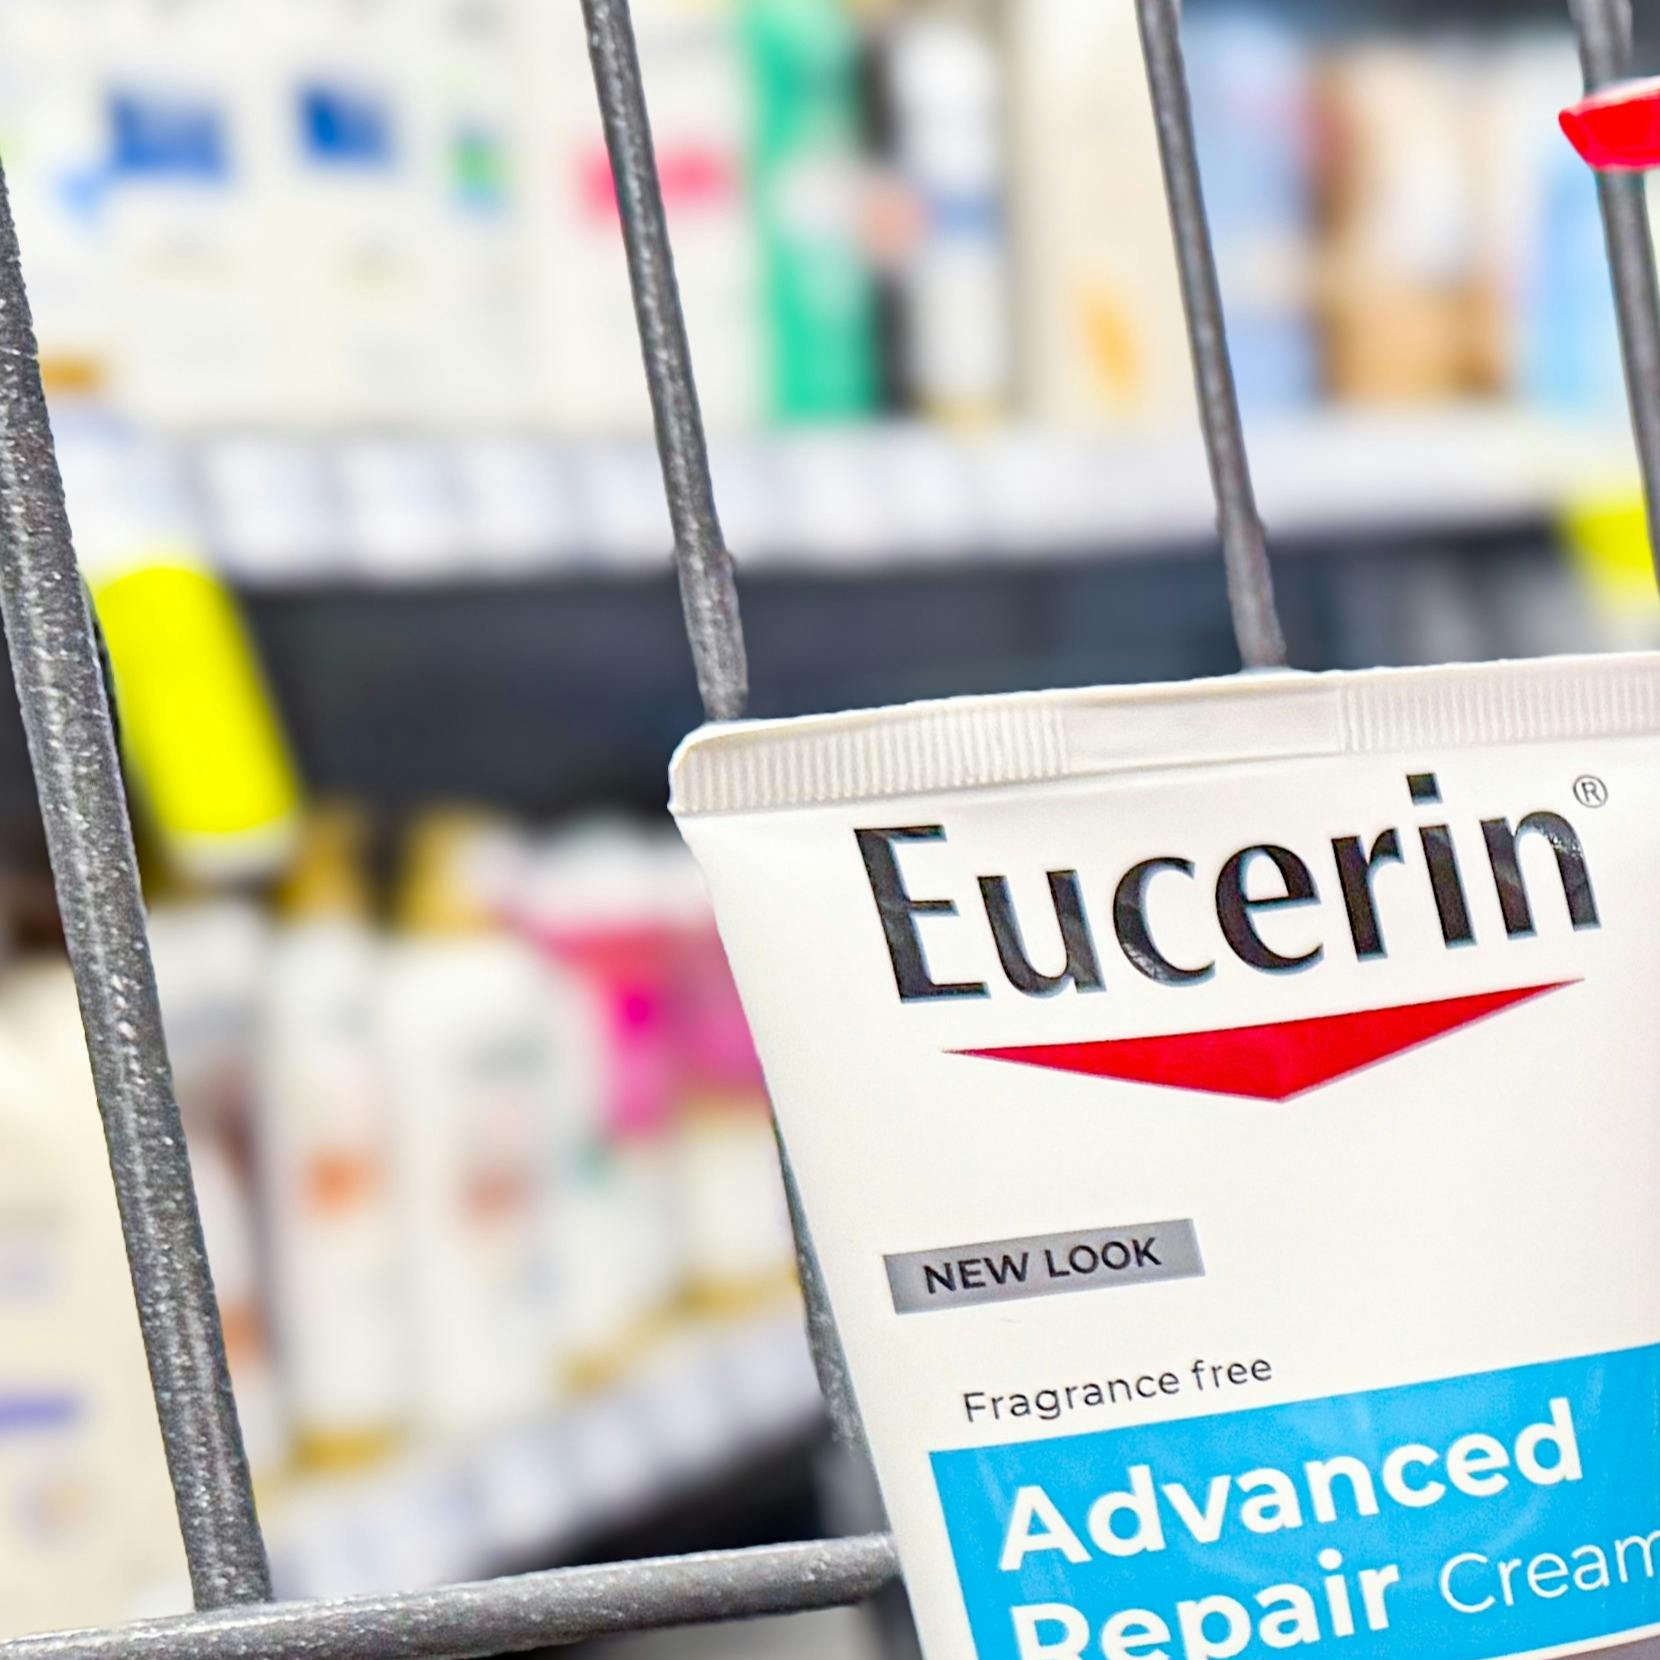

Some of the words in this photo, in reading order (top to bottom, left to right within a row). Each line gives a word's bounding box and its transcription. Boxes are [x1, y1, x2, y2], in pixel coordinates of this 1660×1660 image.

[923, 1253, 1029, 1294] NEW
[1044, 1237, 1161, 1278] LOOK
[964, 1369, 1180, 1422] Fragrance
[1191, 1356, 1273, 1389] free
[1000, 1398, 1583, 1571] Advanced
